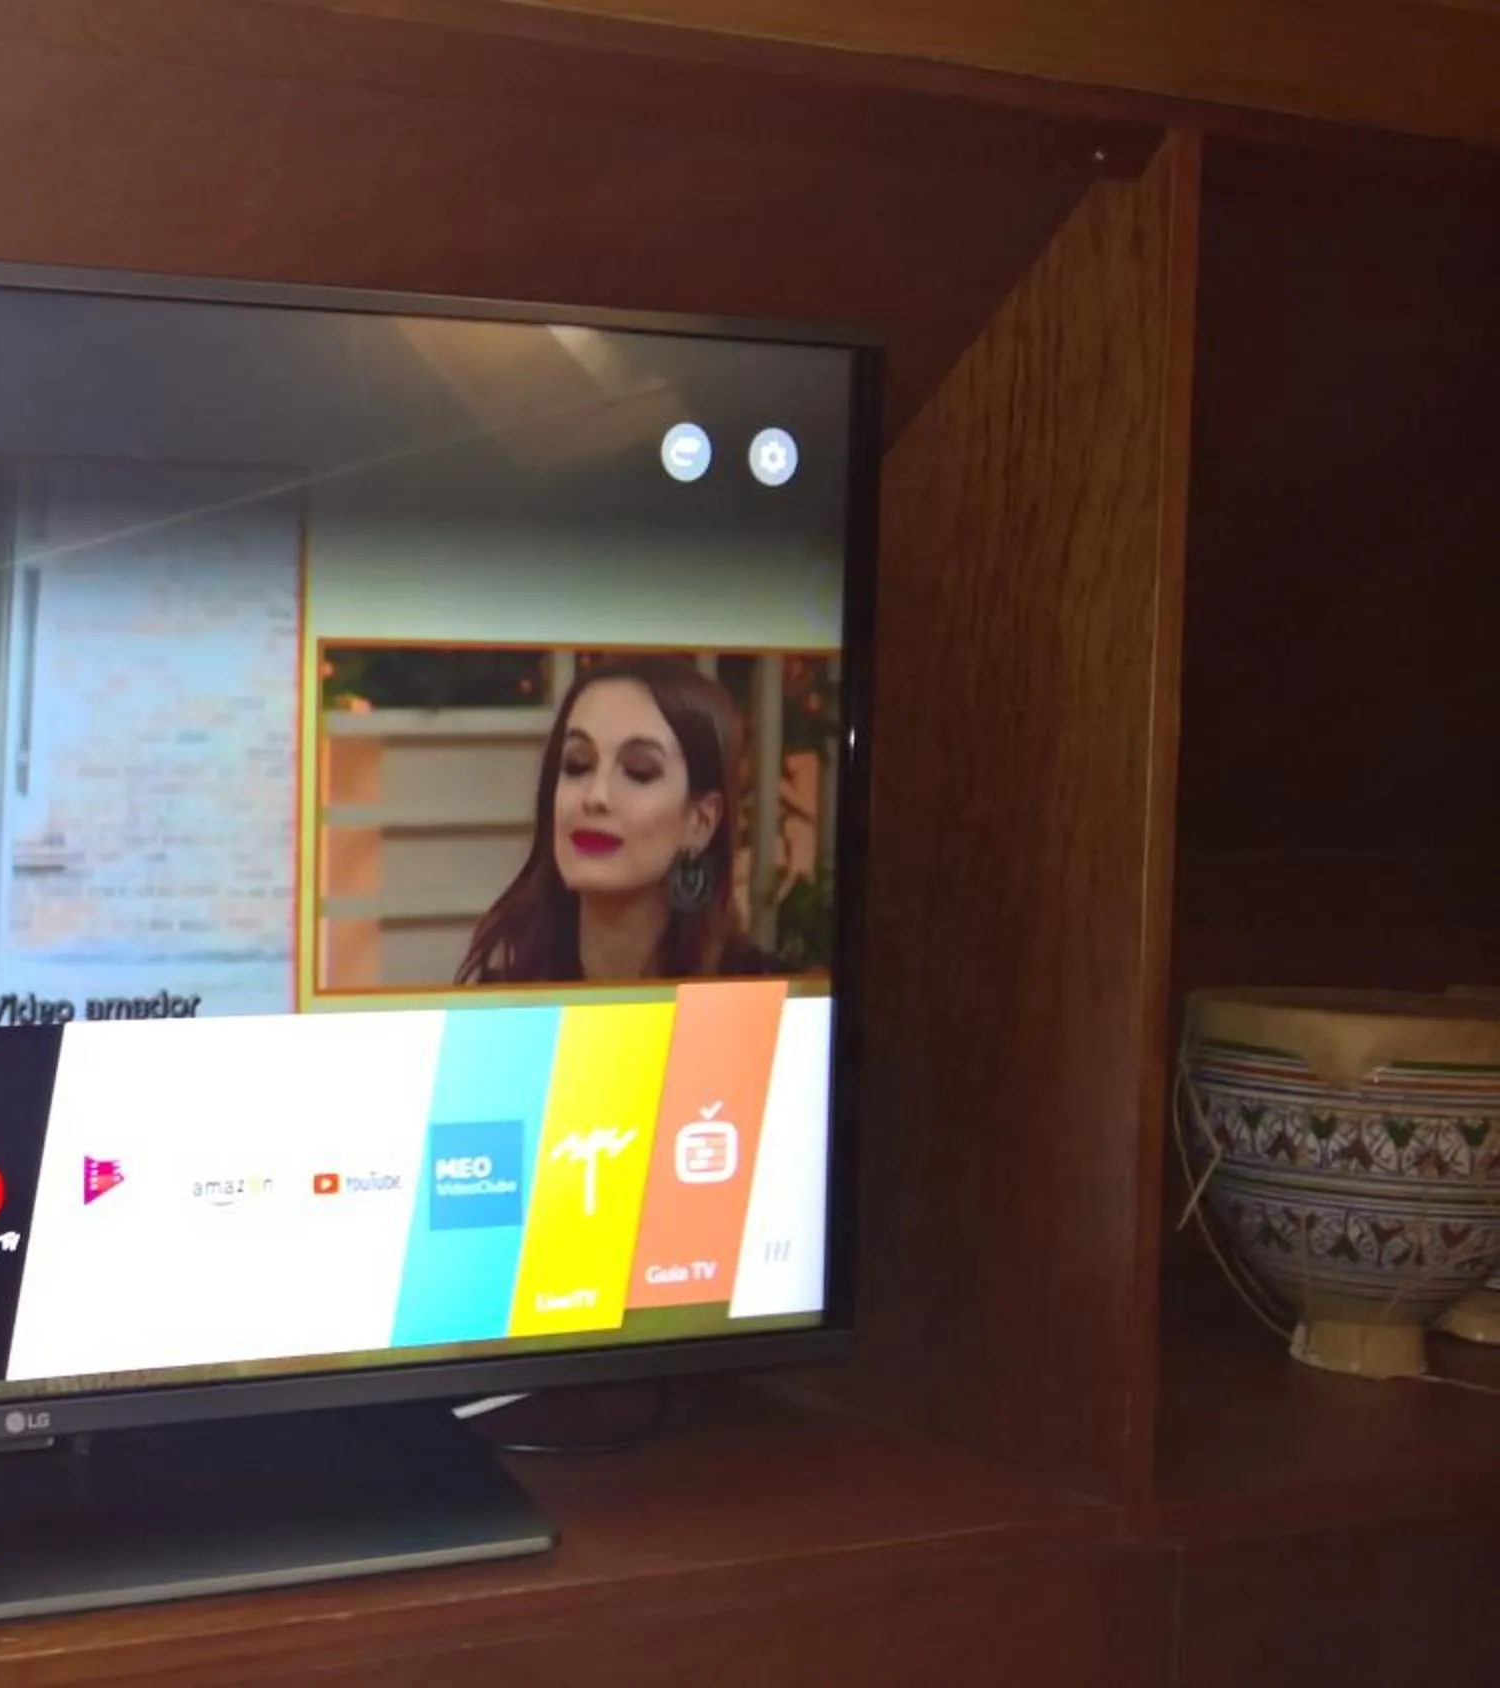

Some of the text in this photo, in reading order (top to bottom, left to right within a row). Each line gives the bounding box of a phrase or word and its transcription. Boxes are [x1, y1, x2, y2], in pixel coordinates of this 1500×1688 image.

[85, 988, 202, 1021] amador
[435, 1156, 493, 1181] MEO
[645, 1260, 718, 1284] Guia TV
[27, 1411, 51, 1430] LG
